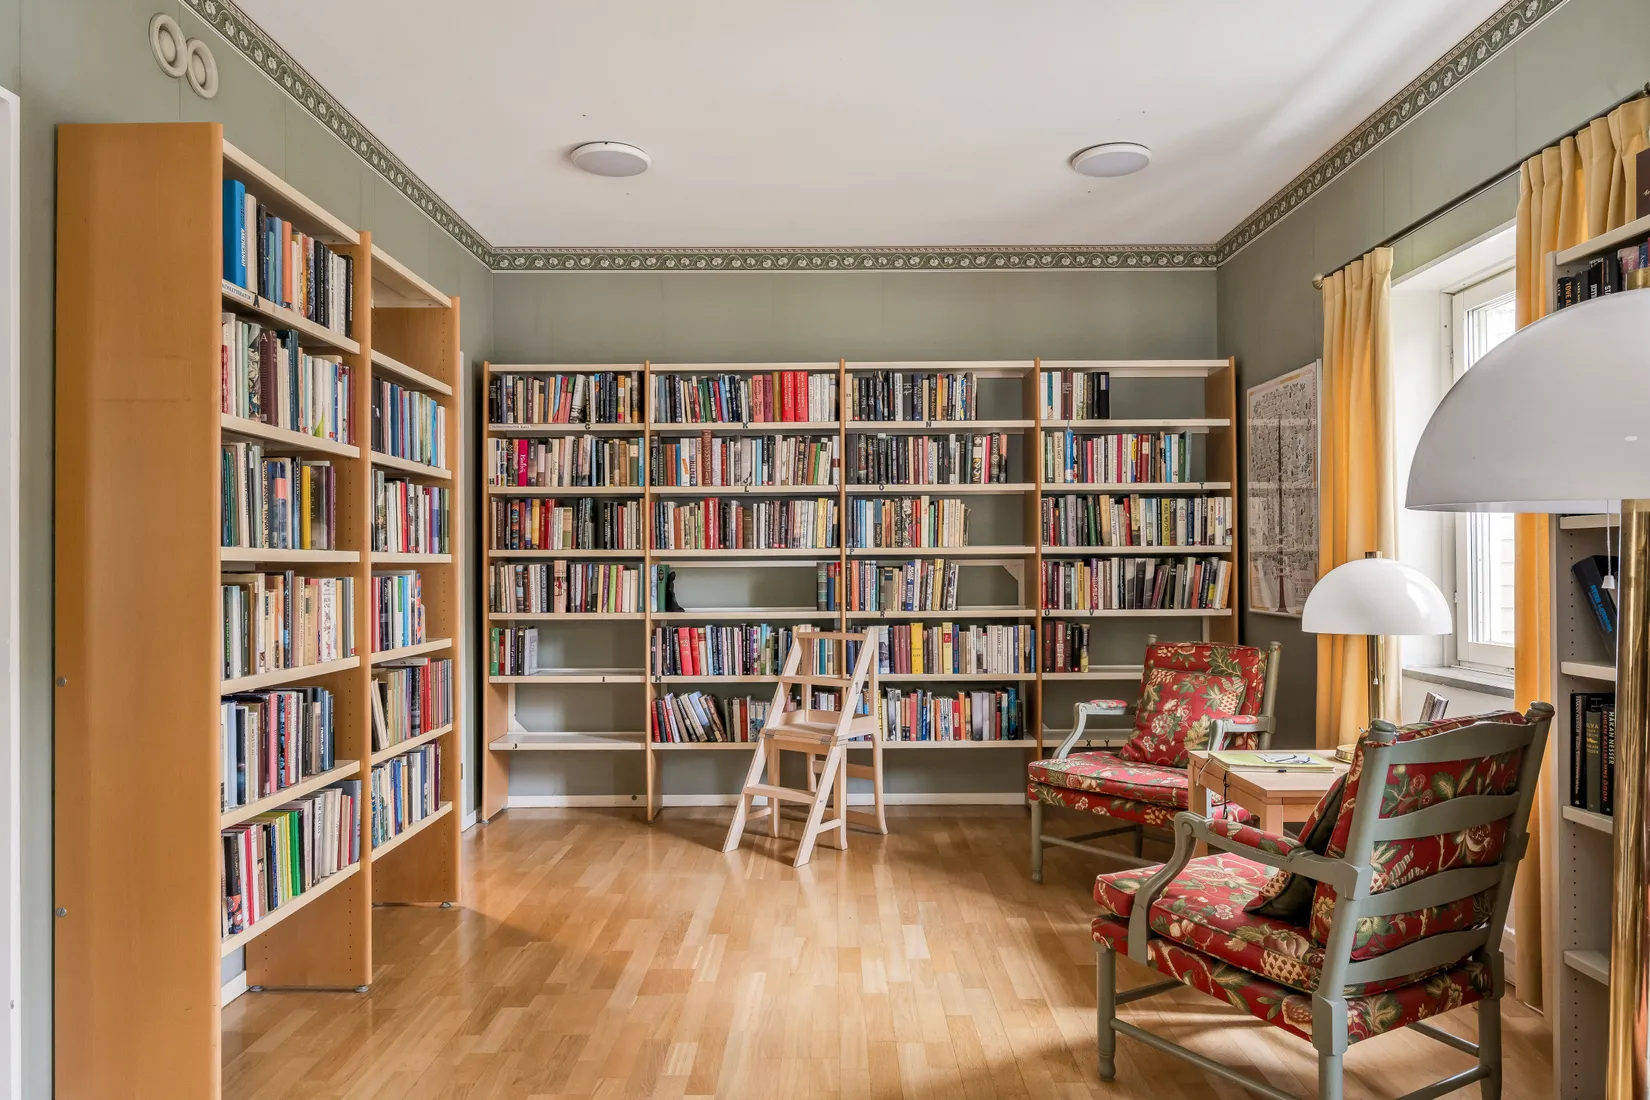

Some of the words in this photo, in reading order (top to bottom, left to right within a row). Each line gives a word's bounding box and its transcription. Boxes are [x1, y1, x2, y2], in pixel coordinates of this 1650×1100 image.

[992, 454, 999, 464] Oz
[879, 610, 886, 618] R
[1044, 609, 1051, 617] U
[655, 675, 662, 683] M
[1086, 739, 1092, 747] X
[1104, 739, 1110, 747] Y
